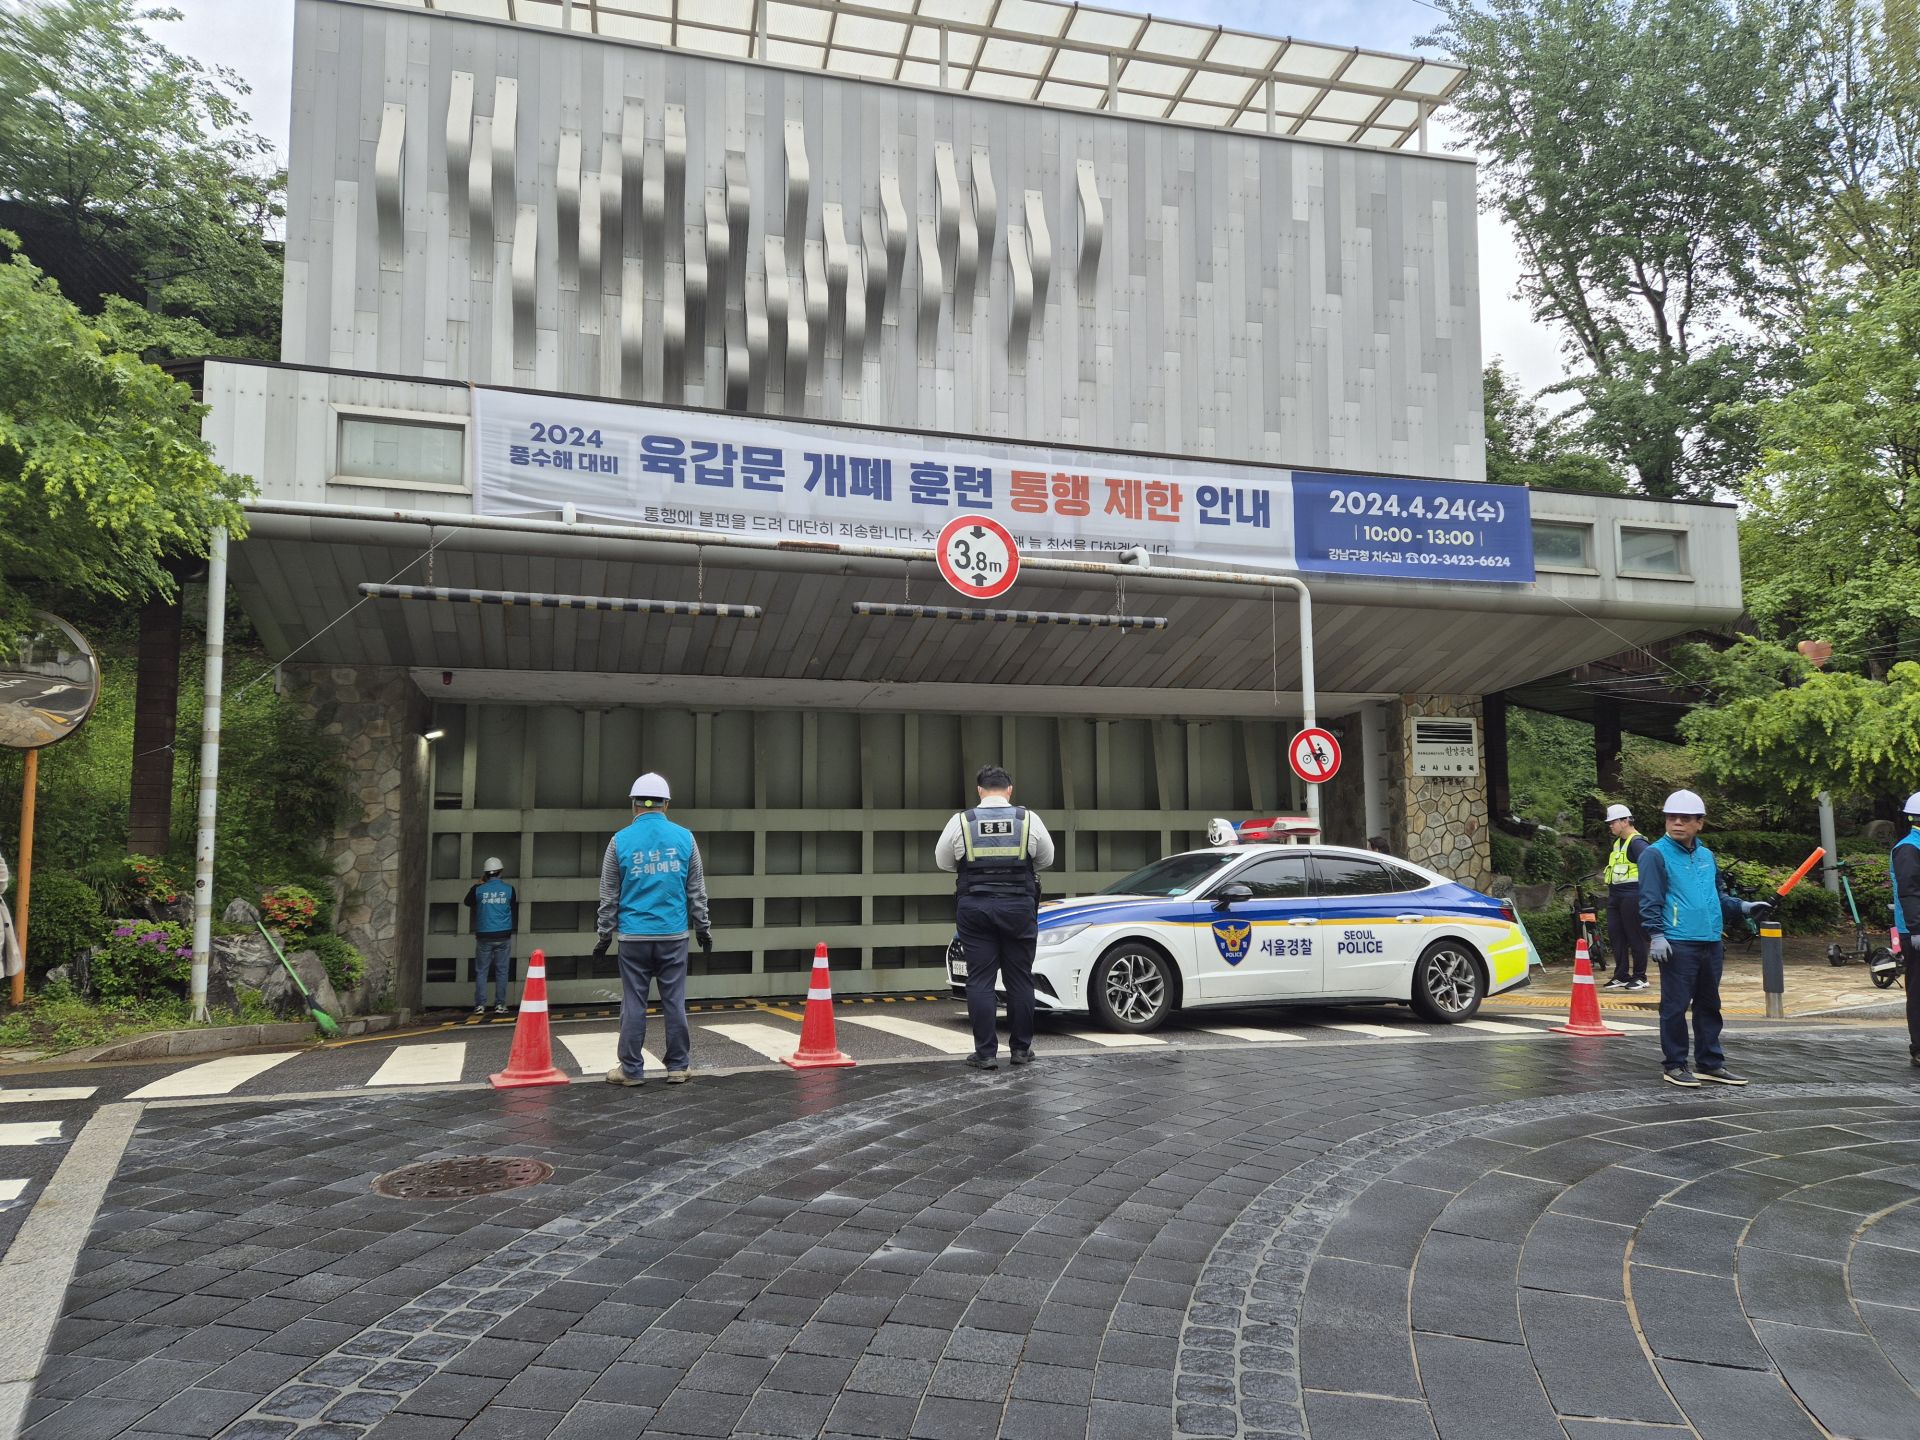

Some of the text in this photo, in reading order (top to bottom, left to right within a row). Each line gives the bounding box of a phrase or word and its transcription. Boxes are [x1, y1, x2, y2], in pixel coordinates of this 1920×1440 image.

[530, 422, 604, 449] 2024
[509, 444, 619, 475] 풍수해 대비
[639, 433, 1271, 529] 육갑문 개폐 훈련 통행 제한 안내
[1329, 489, 1505, 523] 2024.4.24(수)
[644, 506, 693, 526] 통행에
[698, 511, 747, 530] 불편을
[751, 516, 782, 533] 드려
[788, 519, 833, 536] 대단히
[839, 523, 917, 542] 죄송합니다.
[1364, 525, 1412, 544] 10:00
[1427, 529, 1475, 546] 13:00
[954, 539, 1002, 573] 3.8m
[1328, 548, 1511, 568] 강남구청 치수과 02-3423-6624
[984, 822, 1008, 834] 경찰
[632, 847, 678, 864] 강남구
[630, 860, 680, 877] 수해예방
[1344, 930, 1375, 940] SEOUL
[1260, 938, 1313, 956] 서울경찰
[1337, 940, 1383, 955] POLICE
